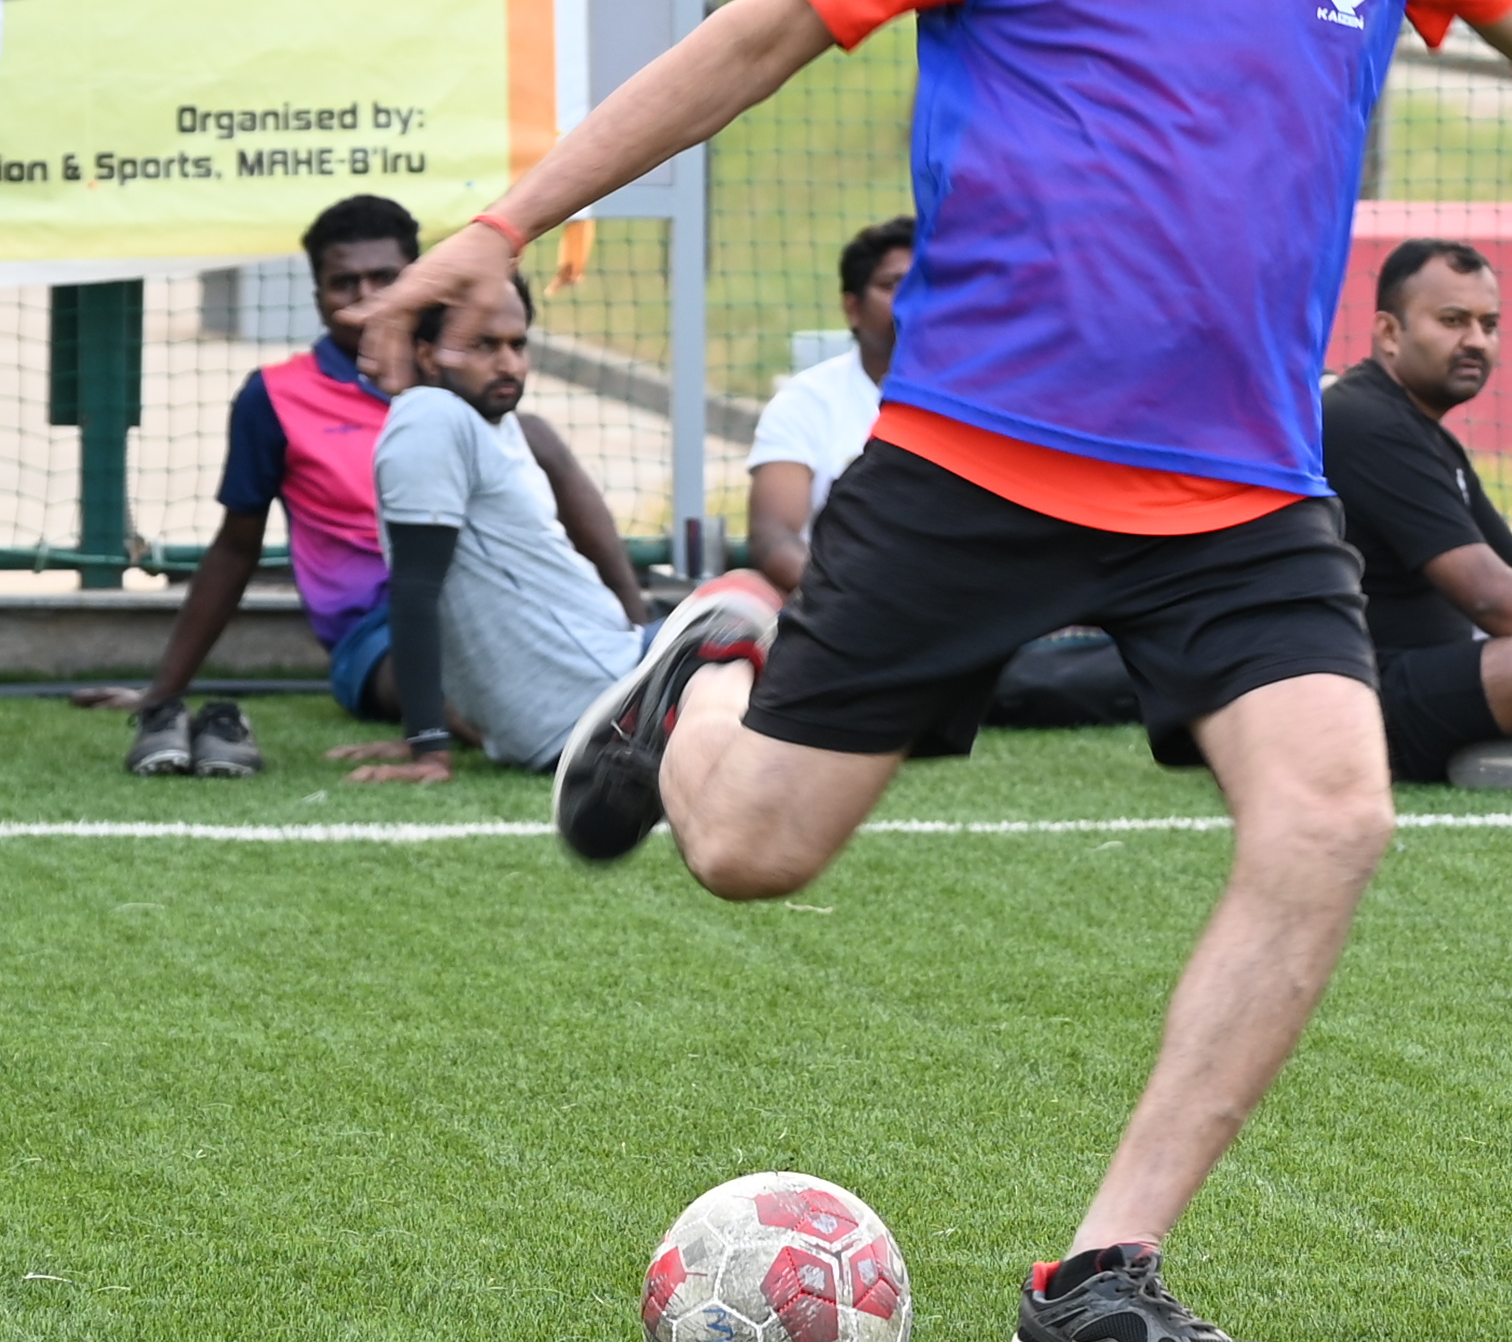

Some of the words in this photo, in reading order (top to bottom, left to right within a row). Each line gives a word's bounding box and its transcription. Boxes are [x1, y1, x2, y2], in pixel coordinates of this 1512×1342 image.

[176, 101, 358, 140] Organised
[372, 101, 425, 136] by:
[62, 152, 83, 182] &
[93, 149, 224, 187] Sports,
